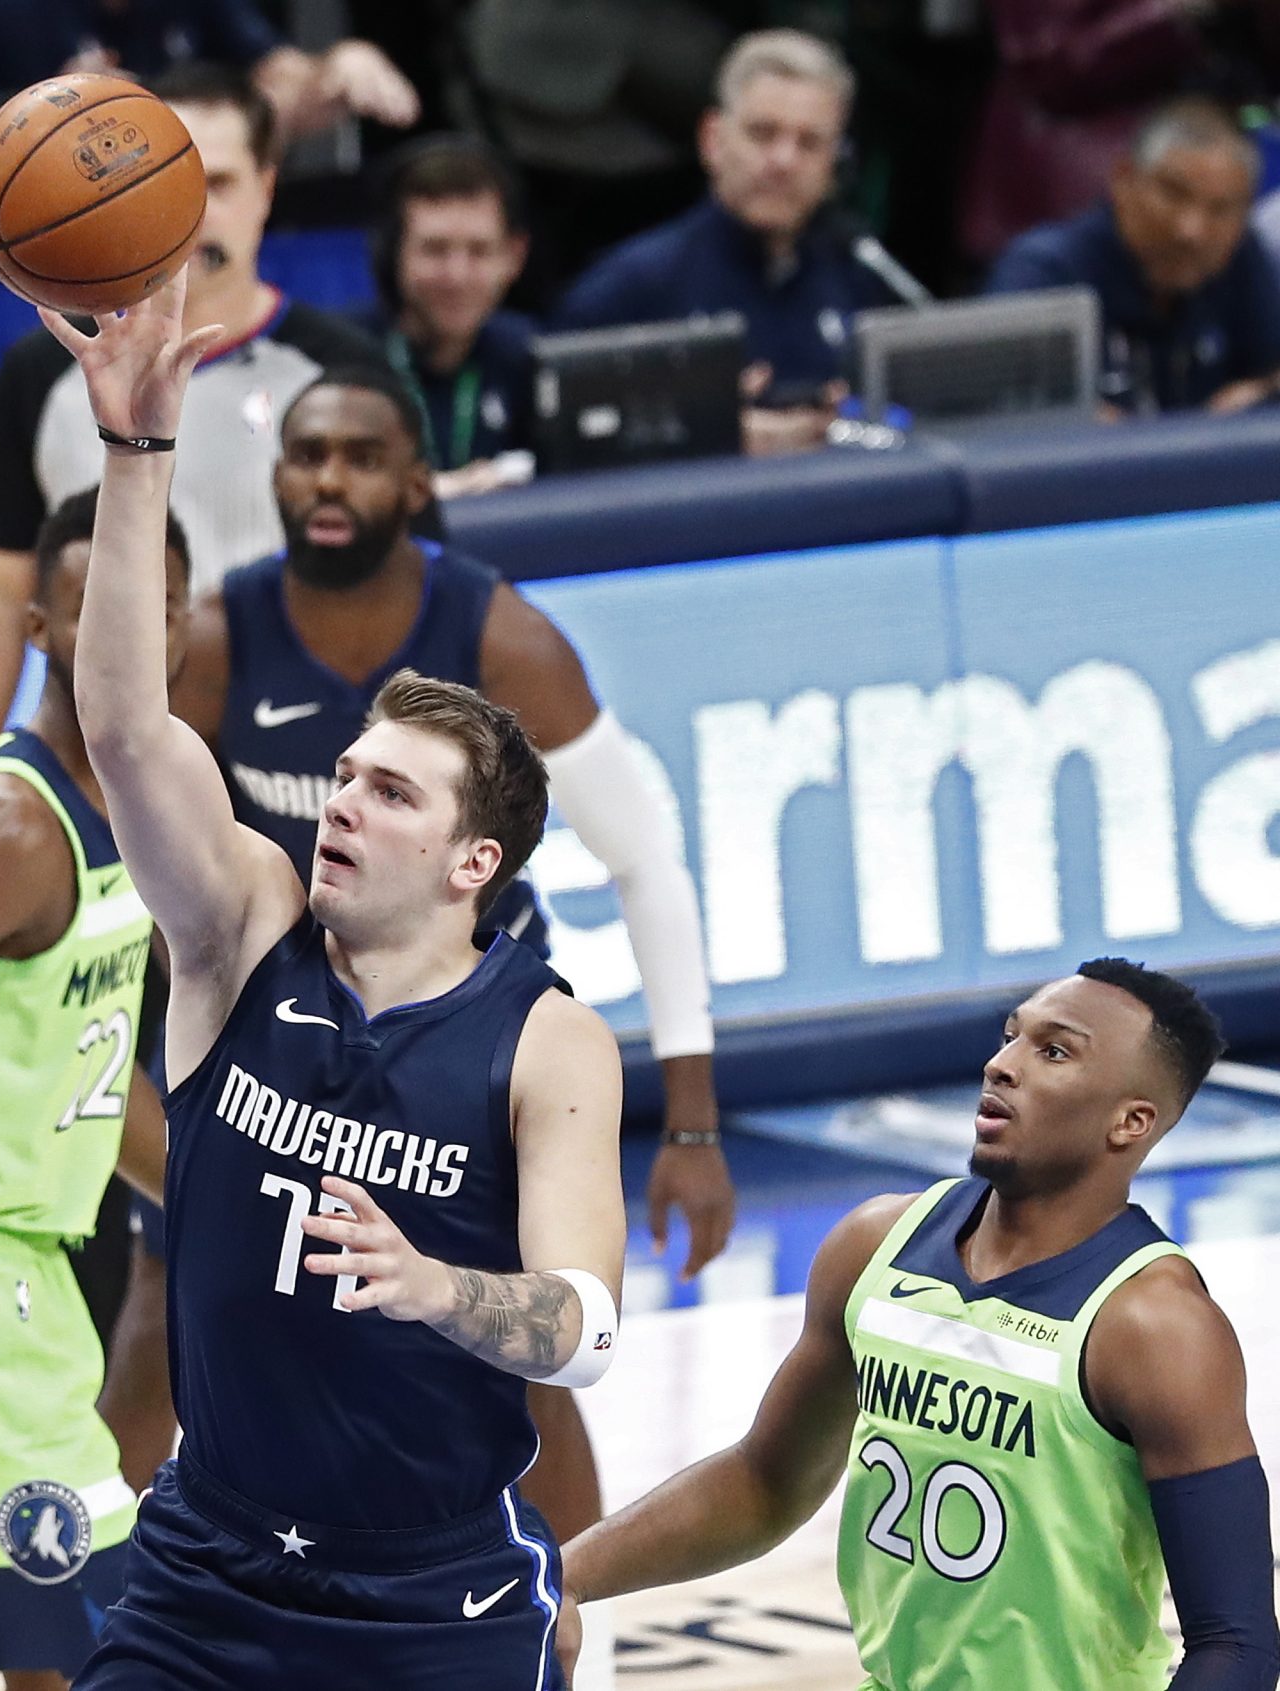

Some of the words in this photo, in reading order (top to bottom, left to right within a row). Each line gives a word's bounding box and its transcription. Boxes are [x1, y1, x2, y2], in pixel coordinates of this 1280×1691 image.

[215, 1063, 470, 1198] MAVERICKS
[1015, 1316, 1060, 1344] fitbit
[859, 1436, 1007, 1583] 20
